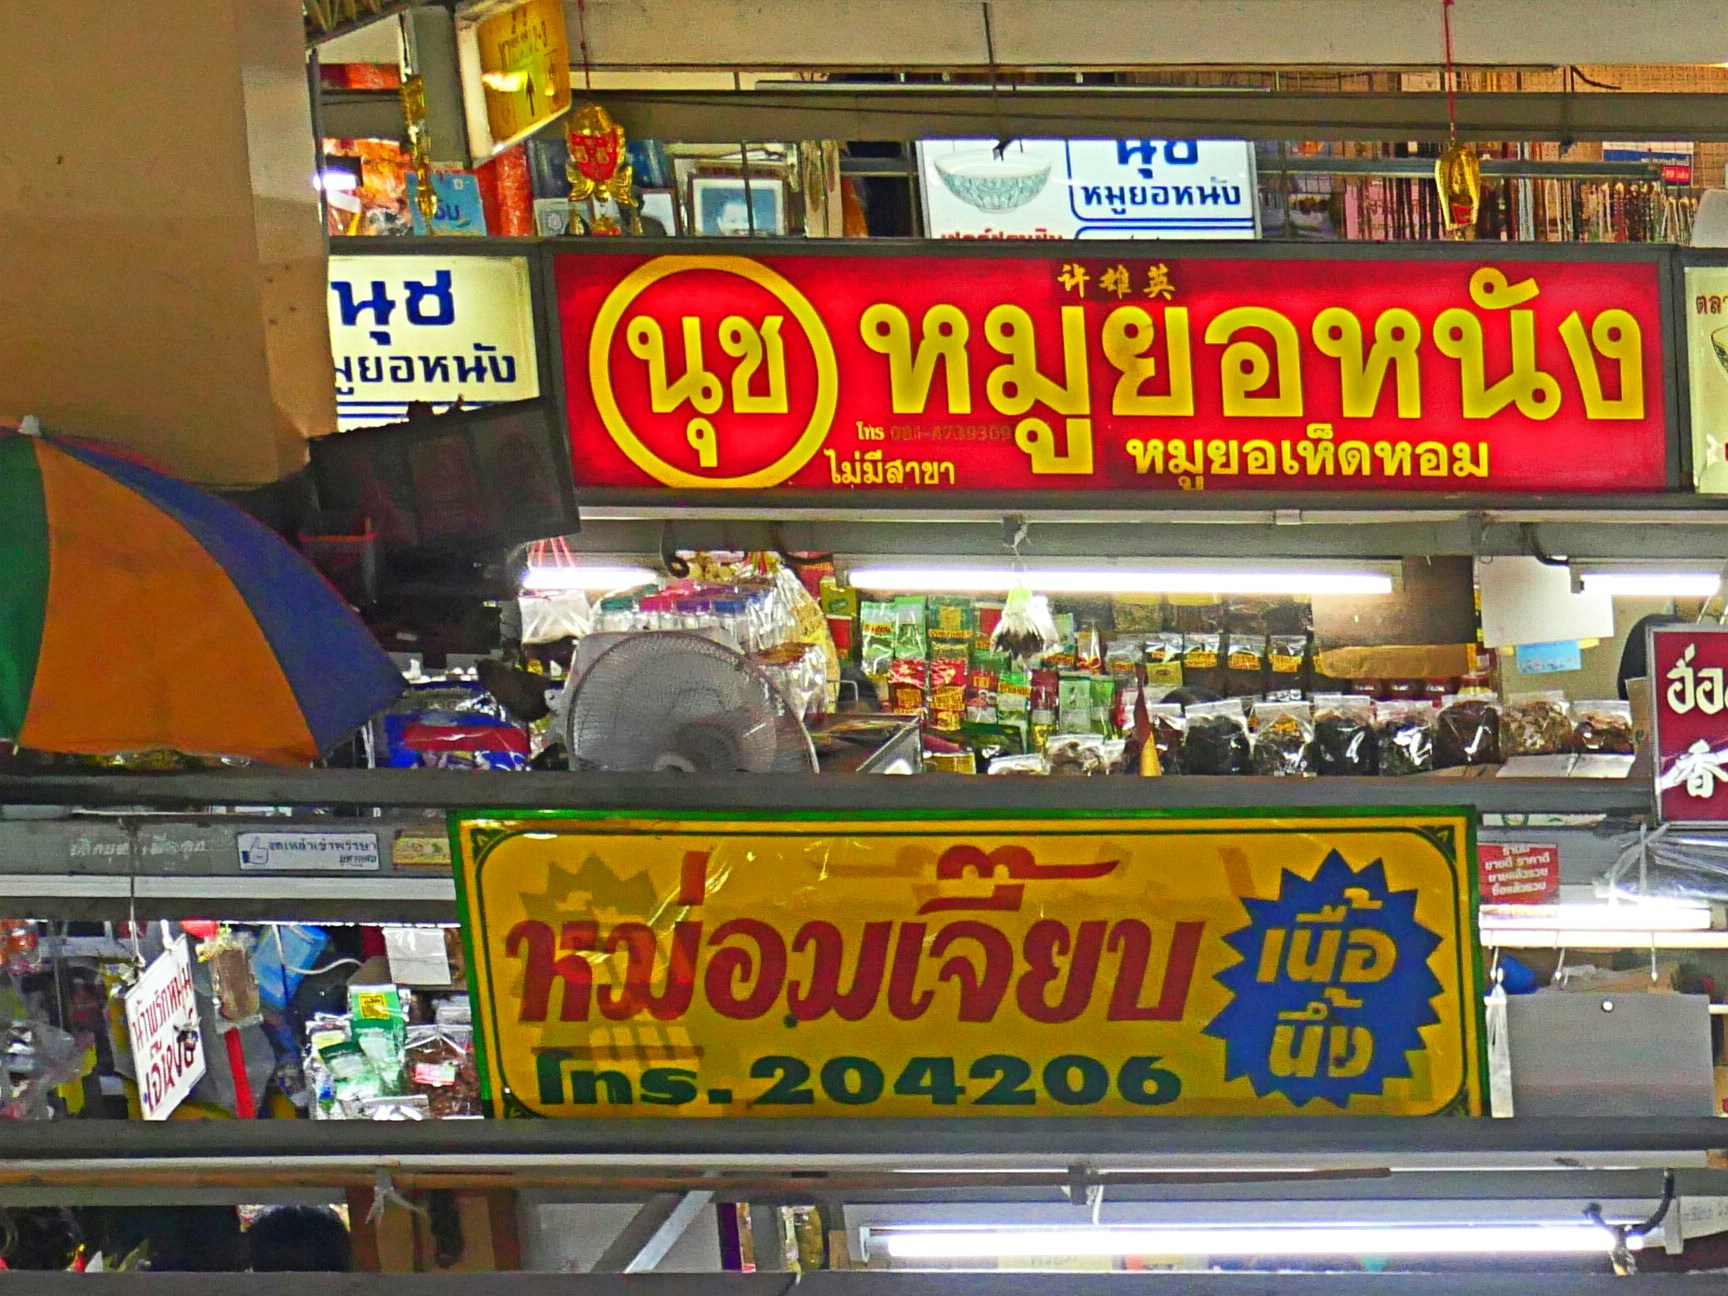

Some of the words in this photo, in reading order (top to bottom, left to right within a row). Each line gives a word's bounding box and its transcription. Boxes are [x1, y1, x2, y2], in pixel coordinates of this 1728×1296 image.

[1080, 176, 1242, 215] หมูยอหนัง
[625, 314, 790, 469] นุช
[859, 266, 1646, 476] หมูยอหนัง
[823, 448, 955, 485] ไม่มีสาขา
[1125, 424, 1490, 490] หมูยอเห็ดหอม
[503, 842, 1205, 1024] หม่อมเจี๊ยบ
[1256, 887, 1400, 985] เนื้อ
